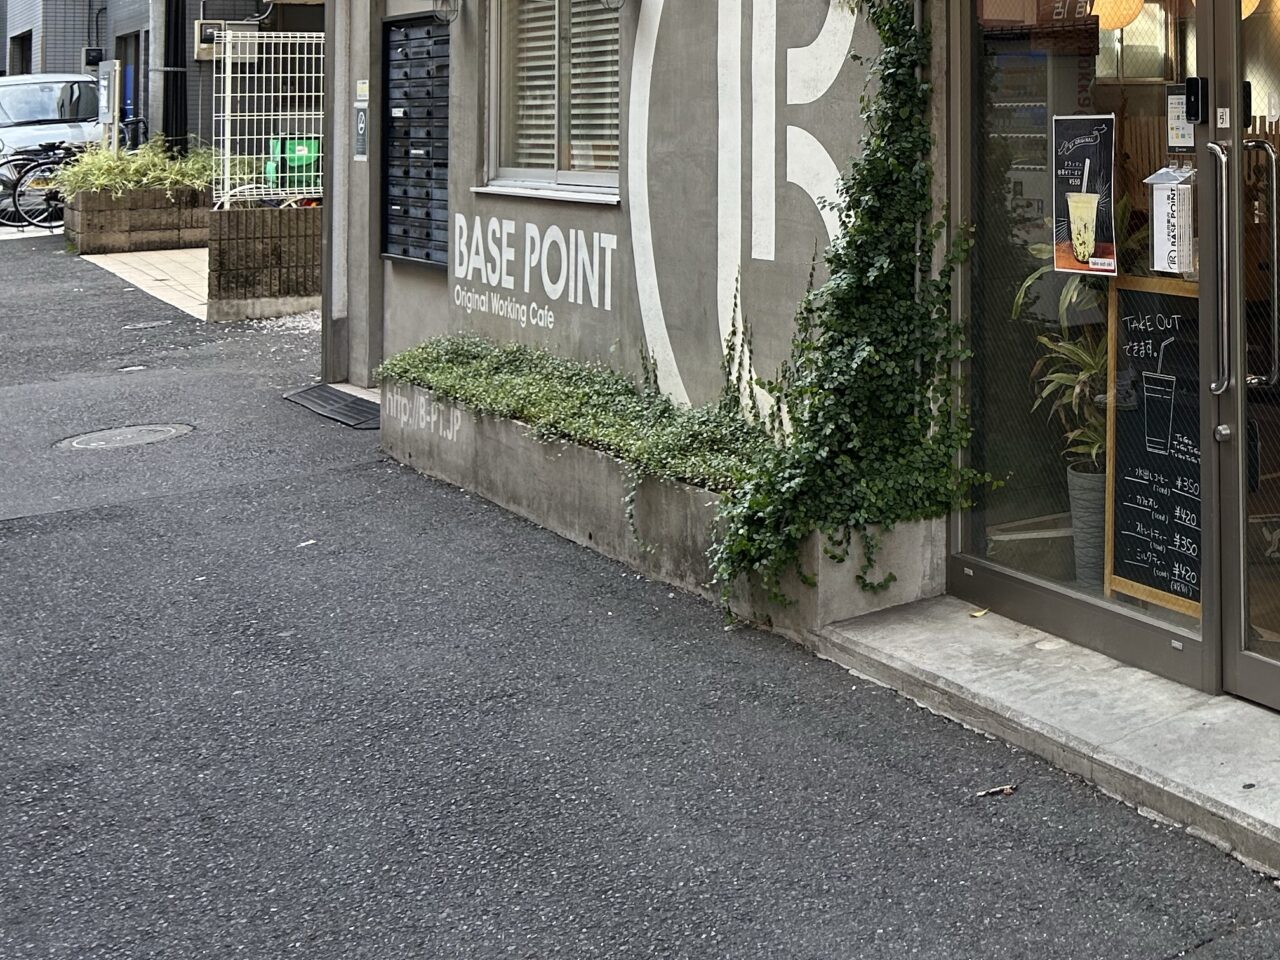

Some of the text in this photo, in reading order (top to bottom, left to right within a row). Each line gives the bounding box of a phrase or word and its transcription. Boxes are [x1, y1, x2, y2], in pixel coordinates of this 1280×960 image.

[454, 212, 618, 311] BASE POINT
[454, 284, 555, 329] Original Working Cafe
[1121, 312, 1182, 332] TAKE OUT
[1122, 339, 1158, 358] できます。
[1175, 476, 1200, 495] ¥350
[1174, 505, 1197, 526] ¥420
[1173, 532, 1198, 557] ¥350
[1172, 561, 1197, 584] ¥420
